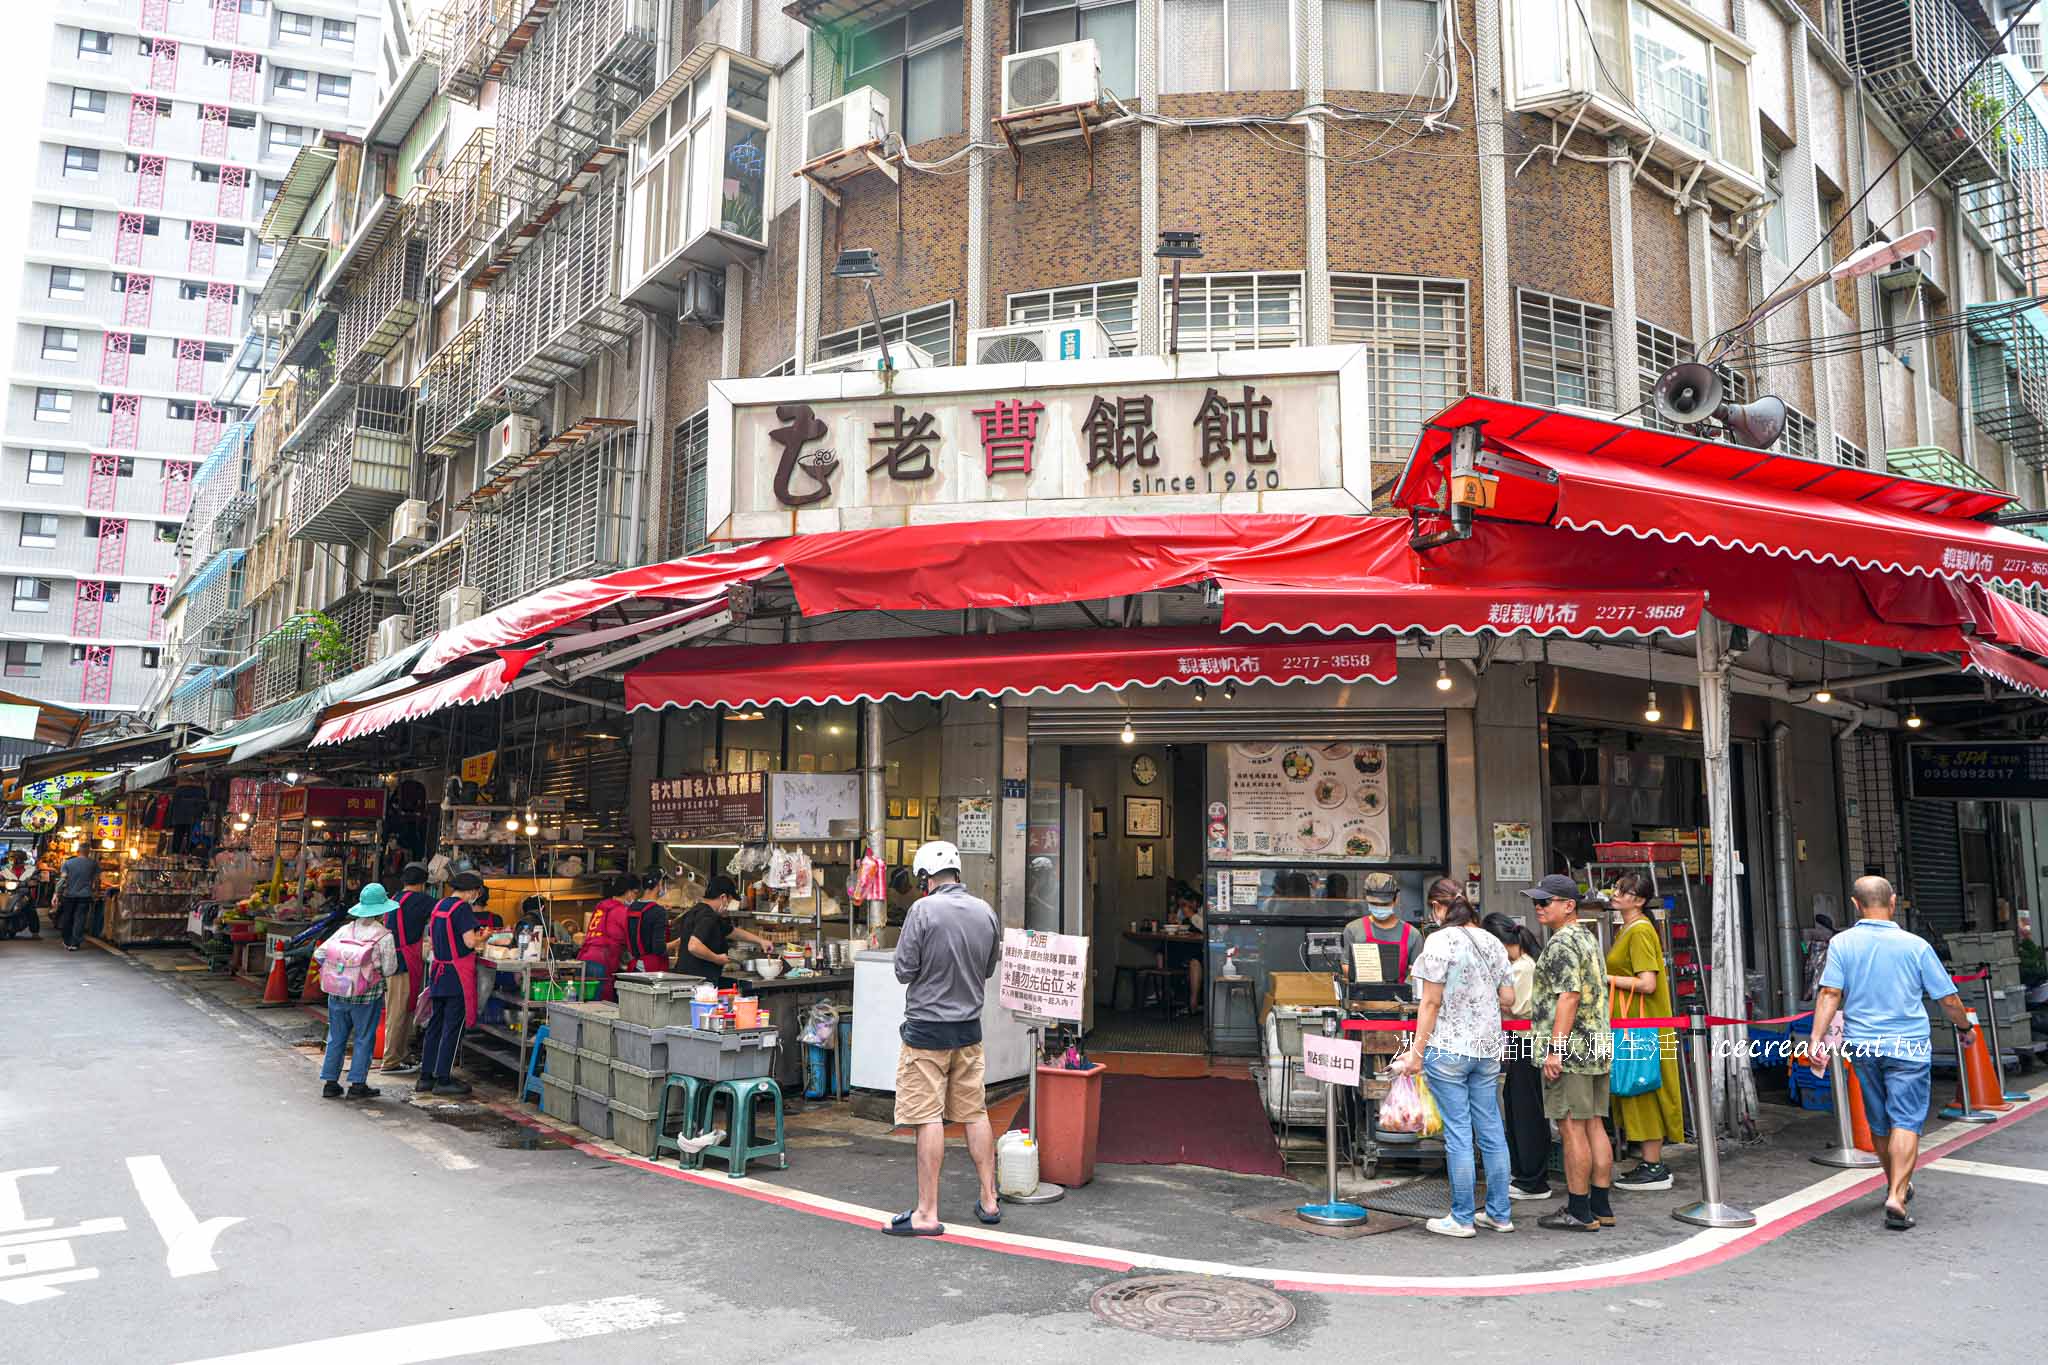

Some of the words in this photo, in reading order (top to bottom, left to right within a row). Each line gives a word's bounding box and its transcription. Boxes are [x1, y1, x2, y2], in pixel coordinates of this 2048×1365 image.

[867, 385, 1278, 481] 老曹餛飩
[1132, 473, 1196, 494] since
[1208, 469, 1280, 494] 1960
[1487, 603, 1580, 624] 親親帆布
[1595, 604, 1685, 620] 2277-3558
[1177, 656, 1261, 675] 親親帆布
[1282, 654, 1371, 670] 2277-3558
